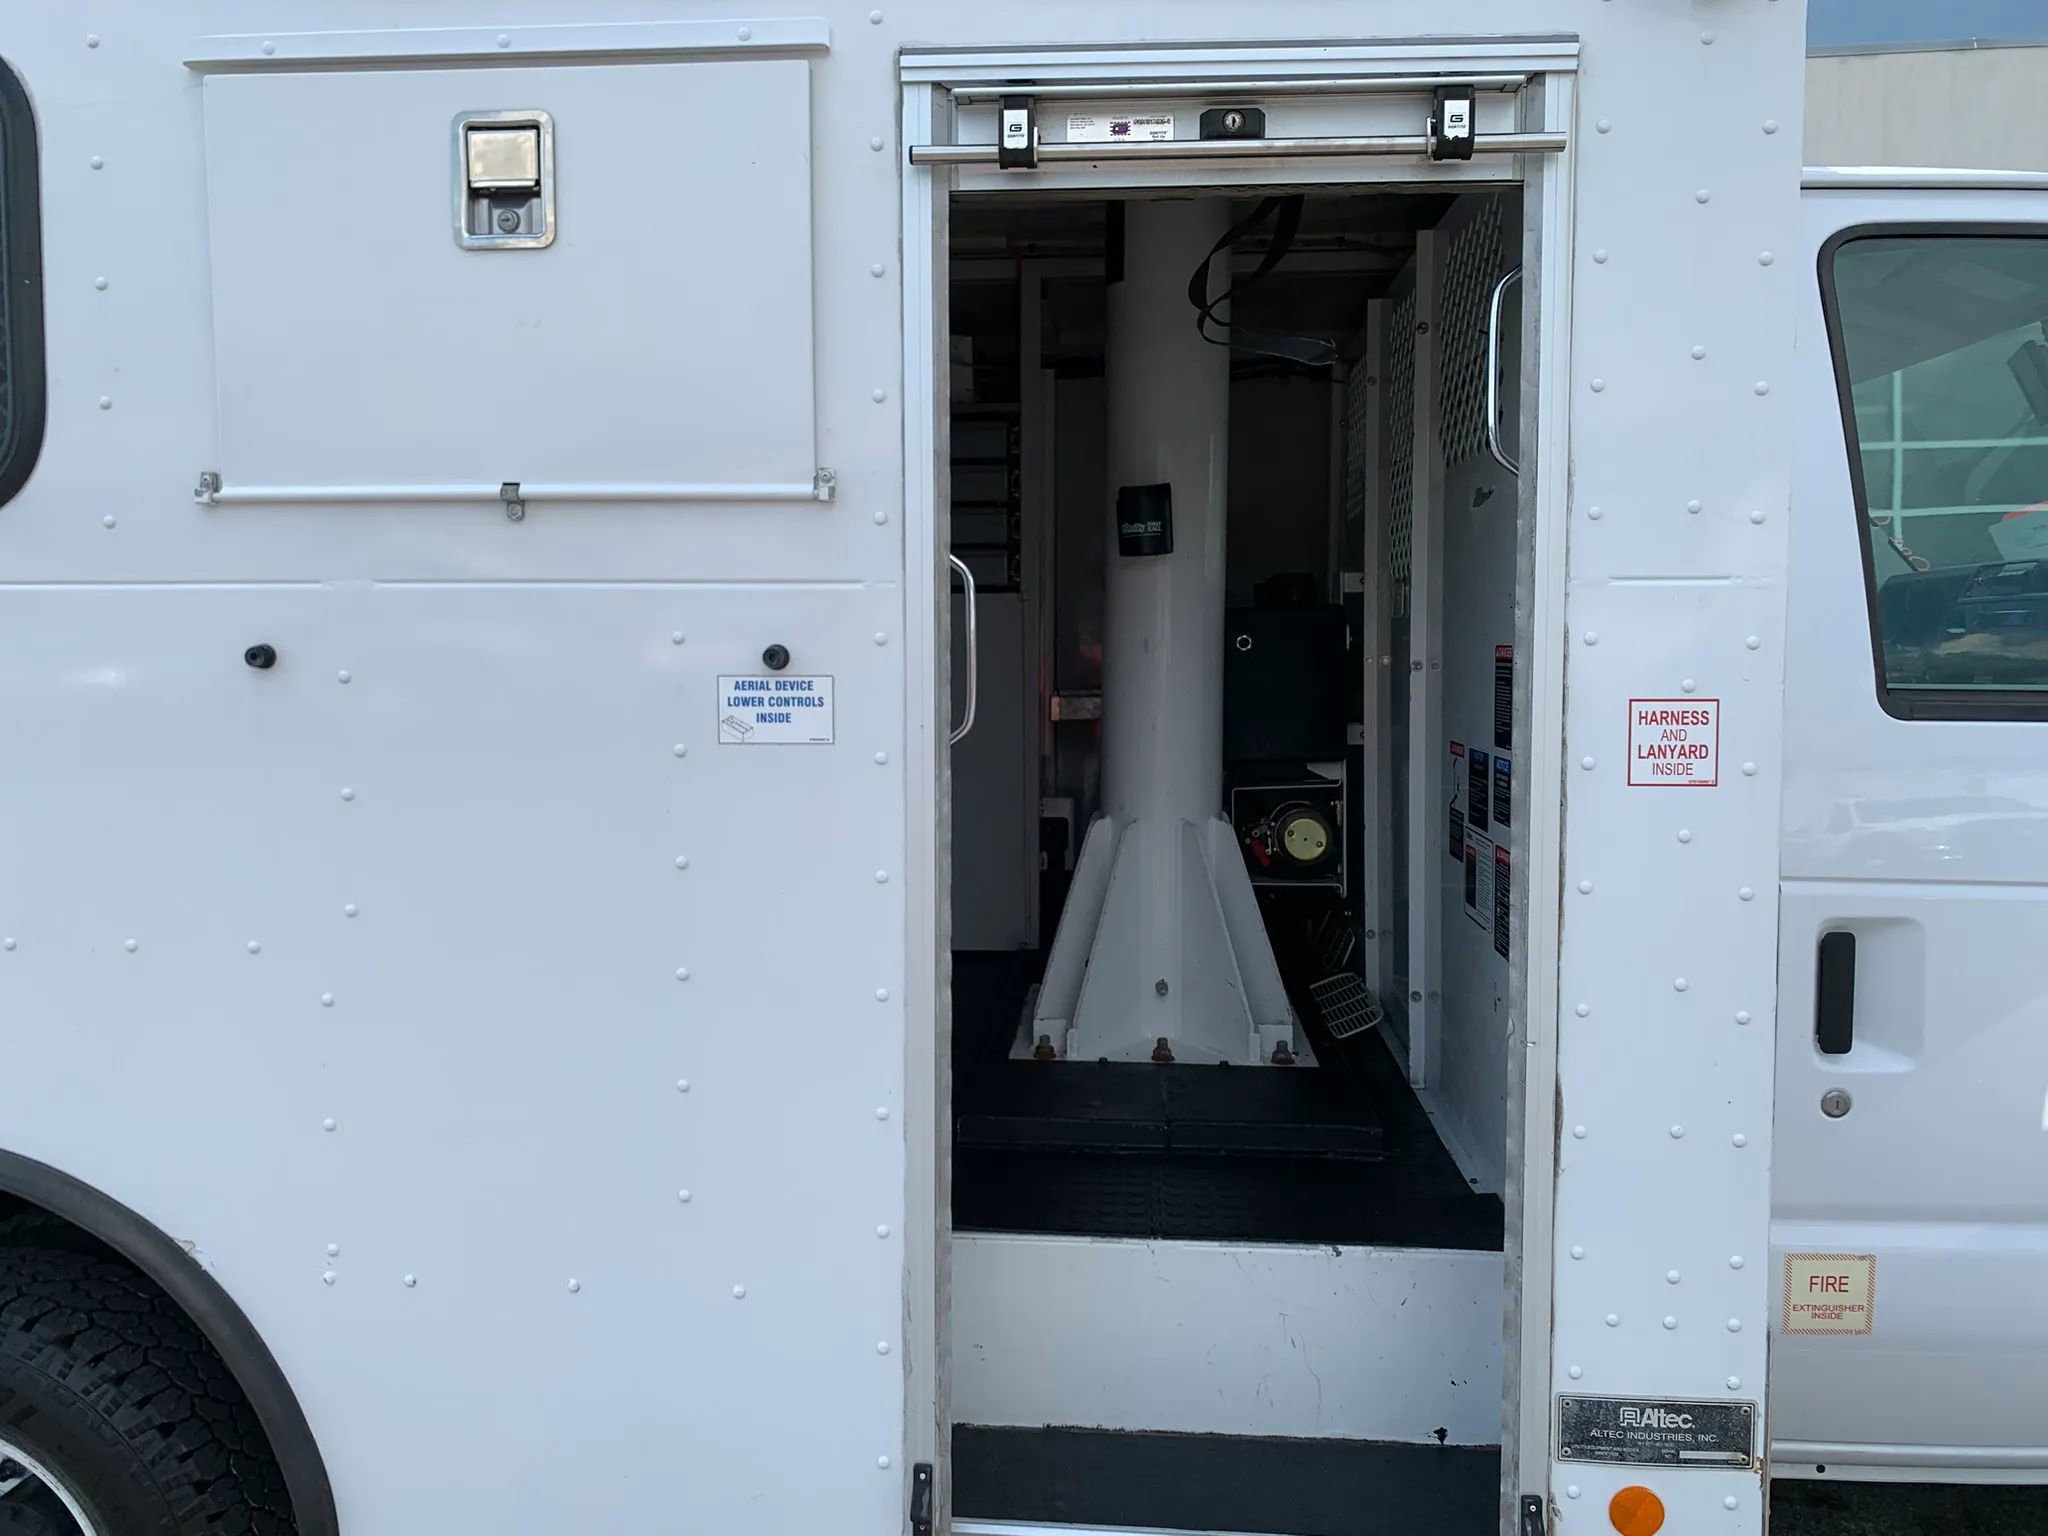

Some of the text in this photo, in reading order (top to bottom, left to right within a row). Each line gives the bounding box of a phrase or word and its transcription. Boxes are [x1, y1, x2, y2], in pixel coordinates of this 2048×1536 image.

[1450, 114, 1464, 123] G
[1009, 123, 1023, 132] G
[734, 680, 814, 691] AERIAL DEVICE
[727, 696, 825, 707] LOWER CONTROLS
[756, 712, 792, 723] INSIDE
[1638, 710, 1710, 726] HARNESS
[1660, 729, 1688, 742] AND
[1638, 744, 1709, 759] LANYARD
[1652, 762, 1694, 776] INSIDE
[1809, 1275, 1850, 1293] FIRE
[1792, 1304, 1865, 1312] EXTINGUISHER
[1811, 1312, 1844, 1320] INSIDE
[1589, 1429, 1719, 1443] ALTEC INDUSTRIES, INC.
